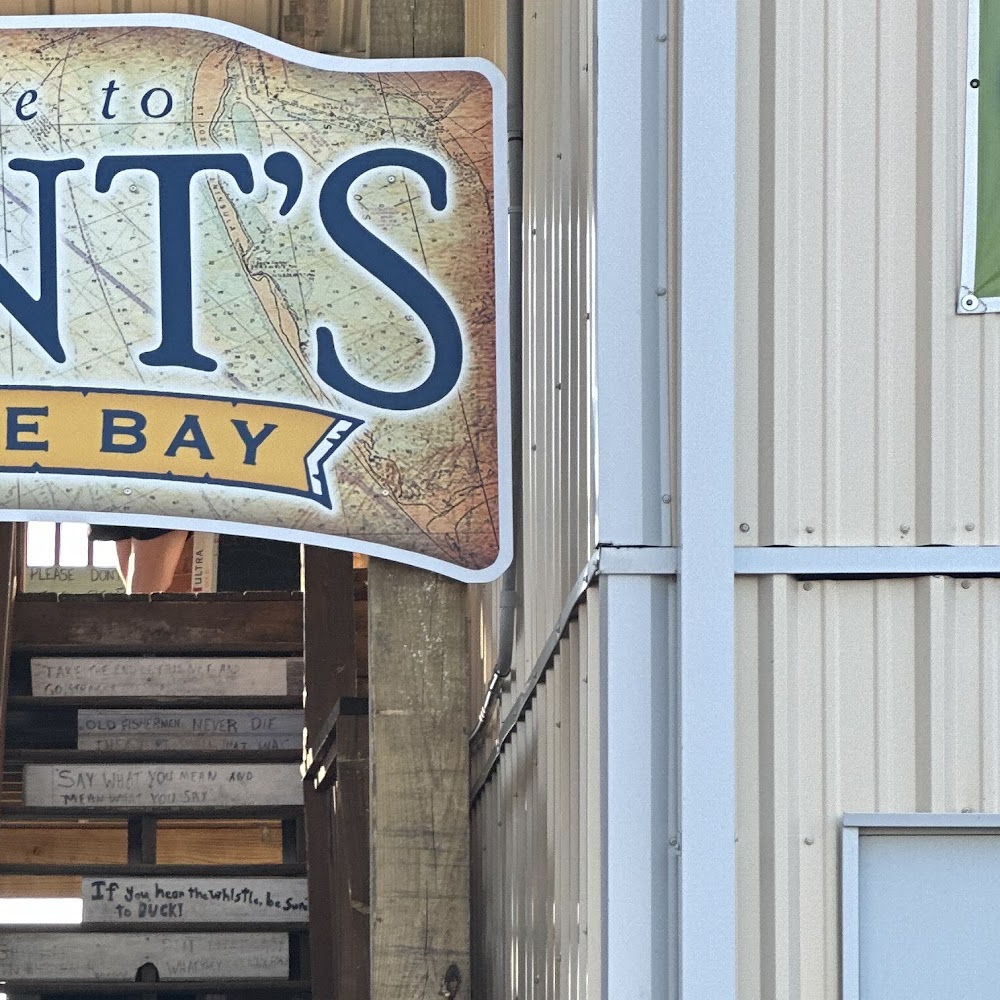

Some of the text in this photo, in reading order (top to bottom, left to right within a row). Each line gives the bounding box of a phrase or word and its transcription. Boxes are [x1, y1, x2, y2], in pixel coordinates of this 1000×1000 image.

[101, 78, 174, 119] to
[100, 409, 279, 466] BAY
[29, 567, 75, 582] PLEASE
[194, 549, 204, 585] ULTRA
[192, 718, 238, 733] NEVER
[91, 881, 120, 900] If
